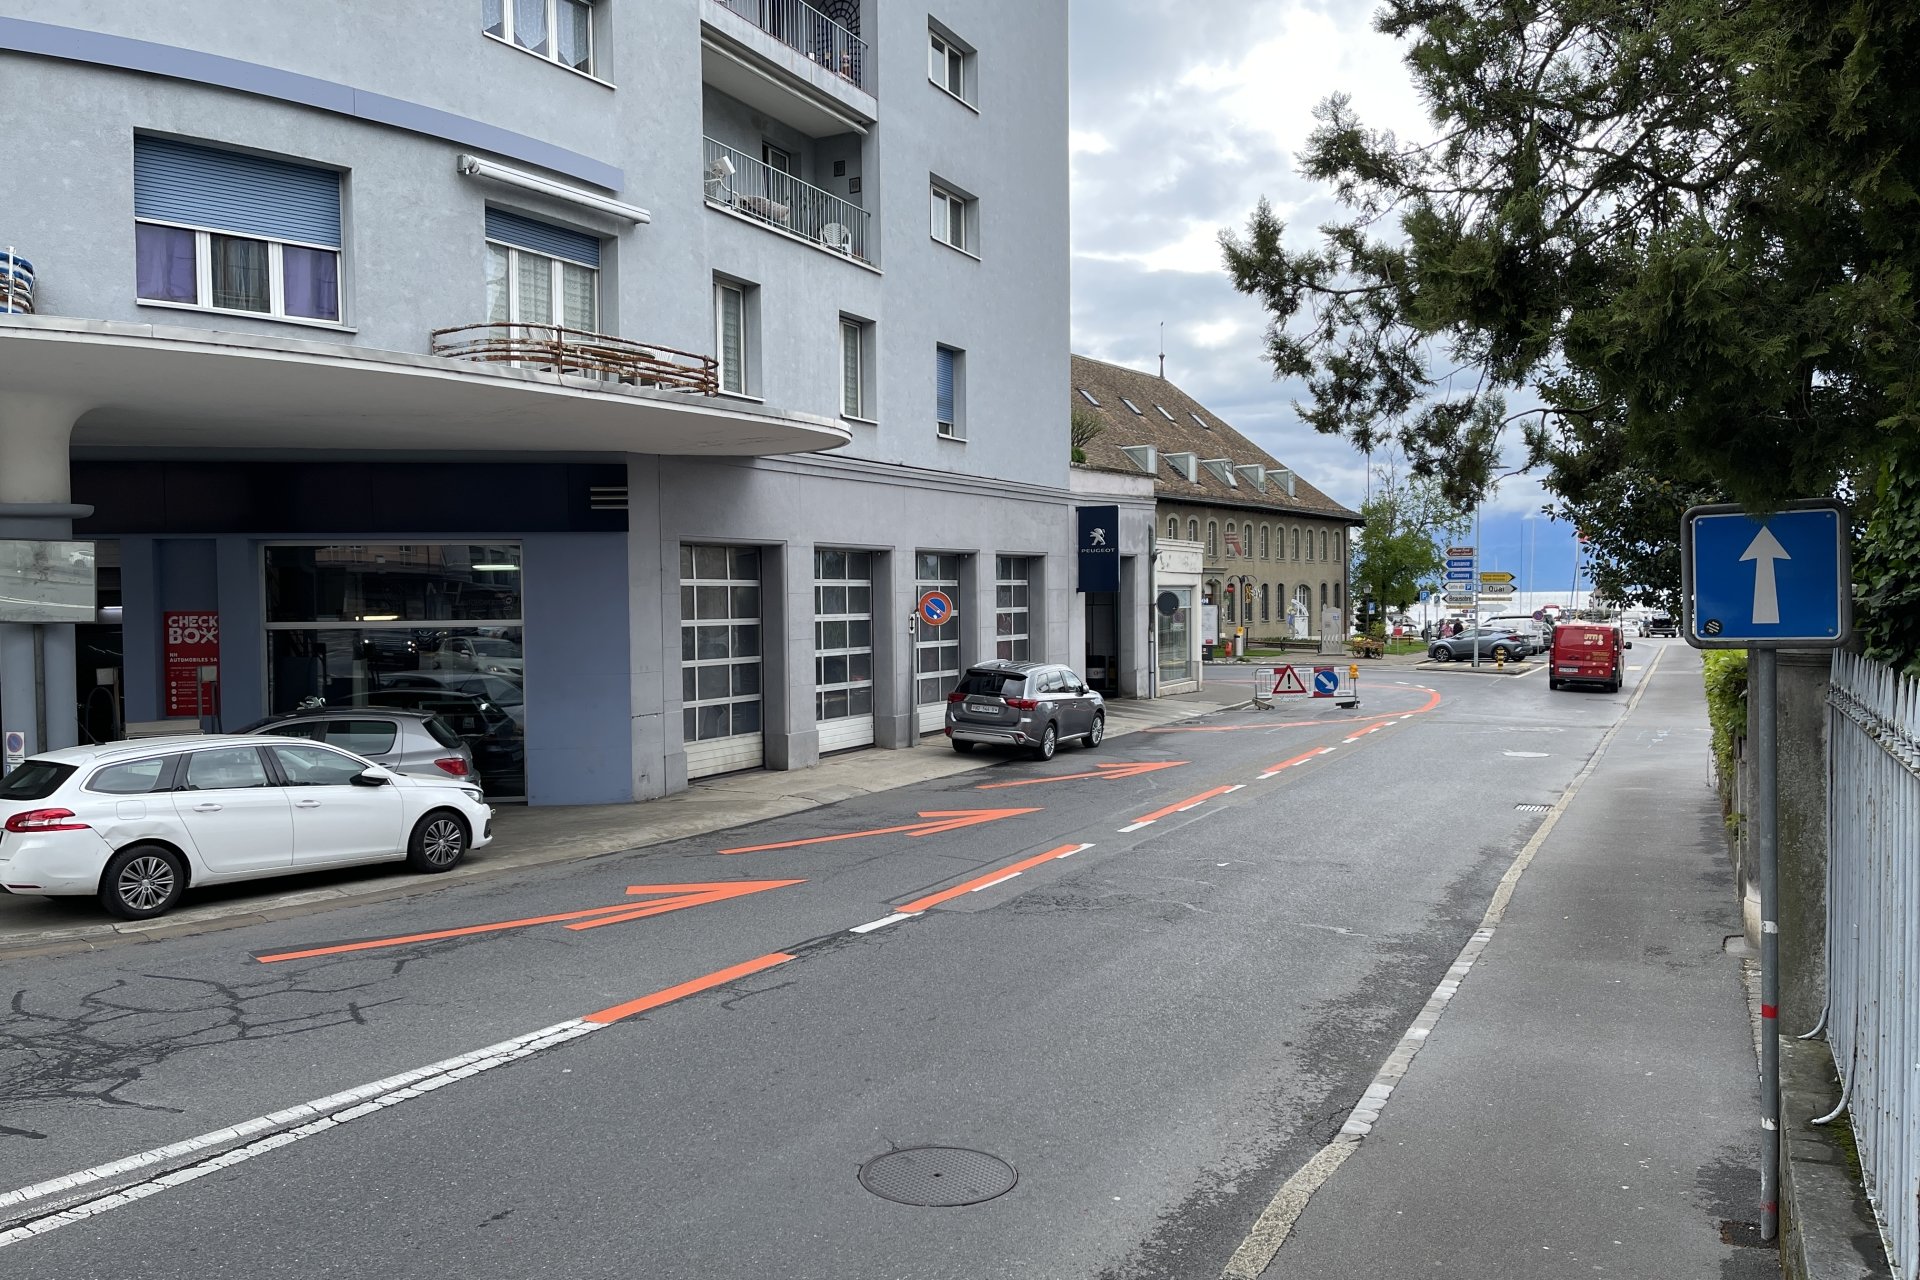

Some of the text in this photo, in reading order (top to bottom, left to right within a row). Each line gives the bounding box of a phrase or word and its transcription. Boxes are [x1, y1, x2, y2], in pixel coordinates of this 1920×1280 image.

[1488, 585, 1504, 593] Quai
[168, 615, 218, 627] CHECK
[168, 627, 218, 644] BOX
